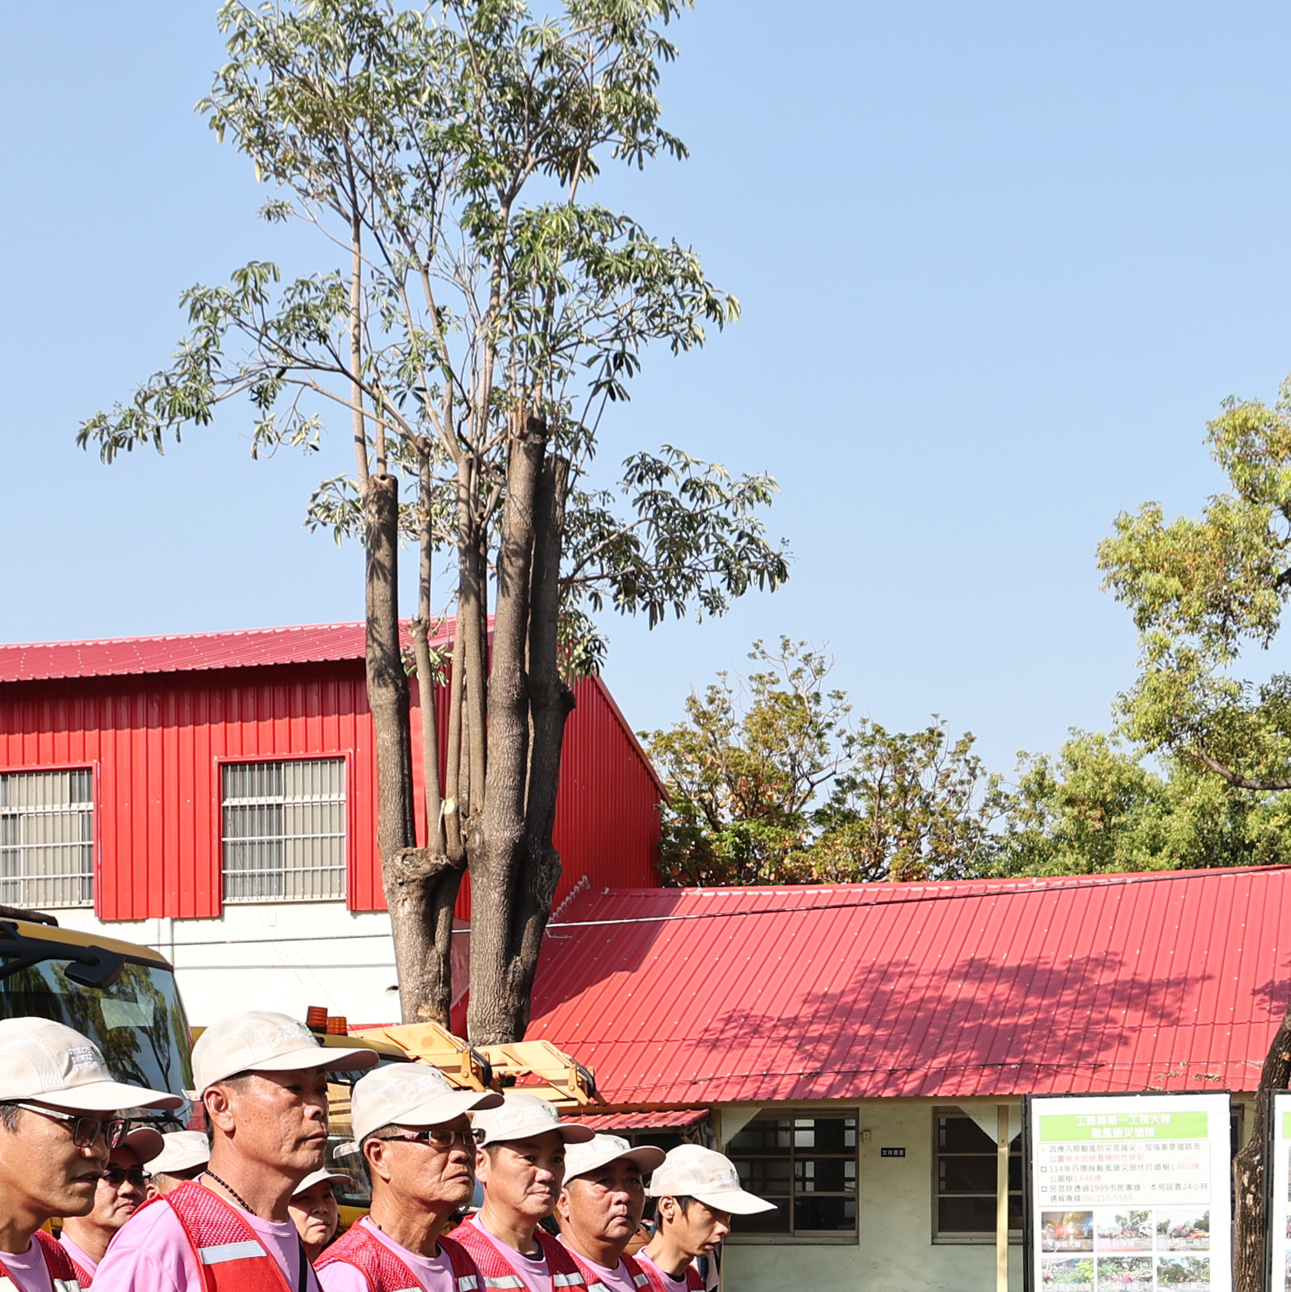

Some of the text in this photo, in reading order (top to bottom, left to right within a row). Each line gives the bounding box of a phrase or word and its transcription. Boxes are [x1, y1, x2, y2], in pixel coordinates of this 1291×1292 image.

[1075, 1114, 1172, 1126] 工務局第一工務大隊
